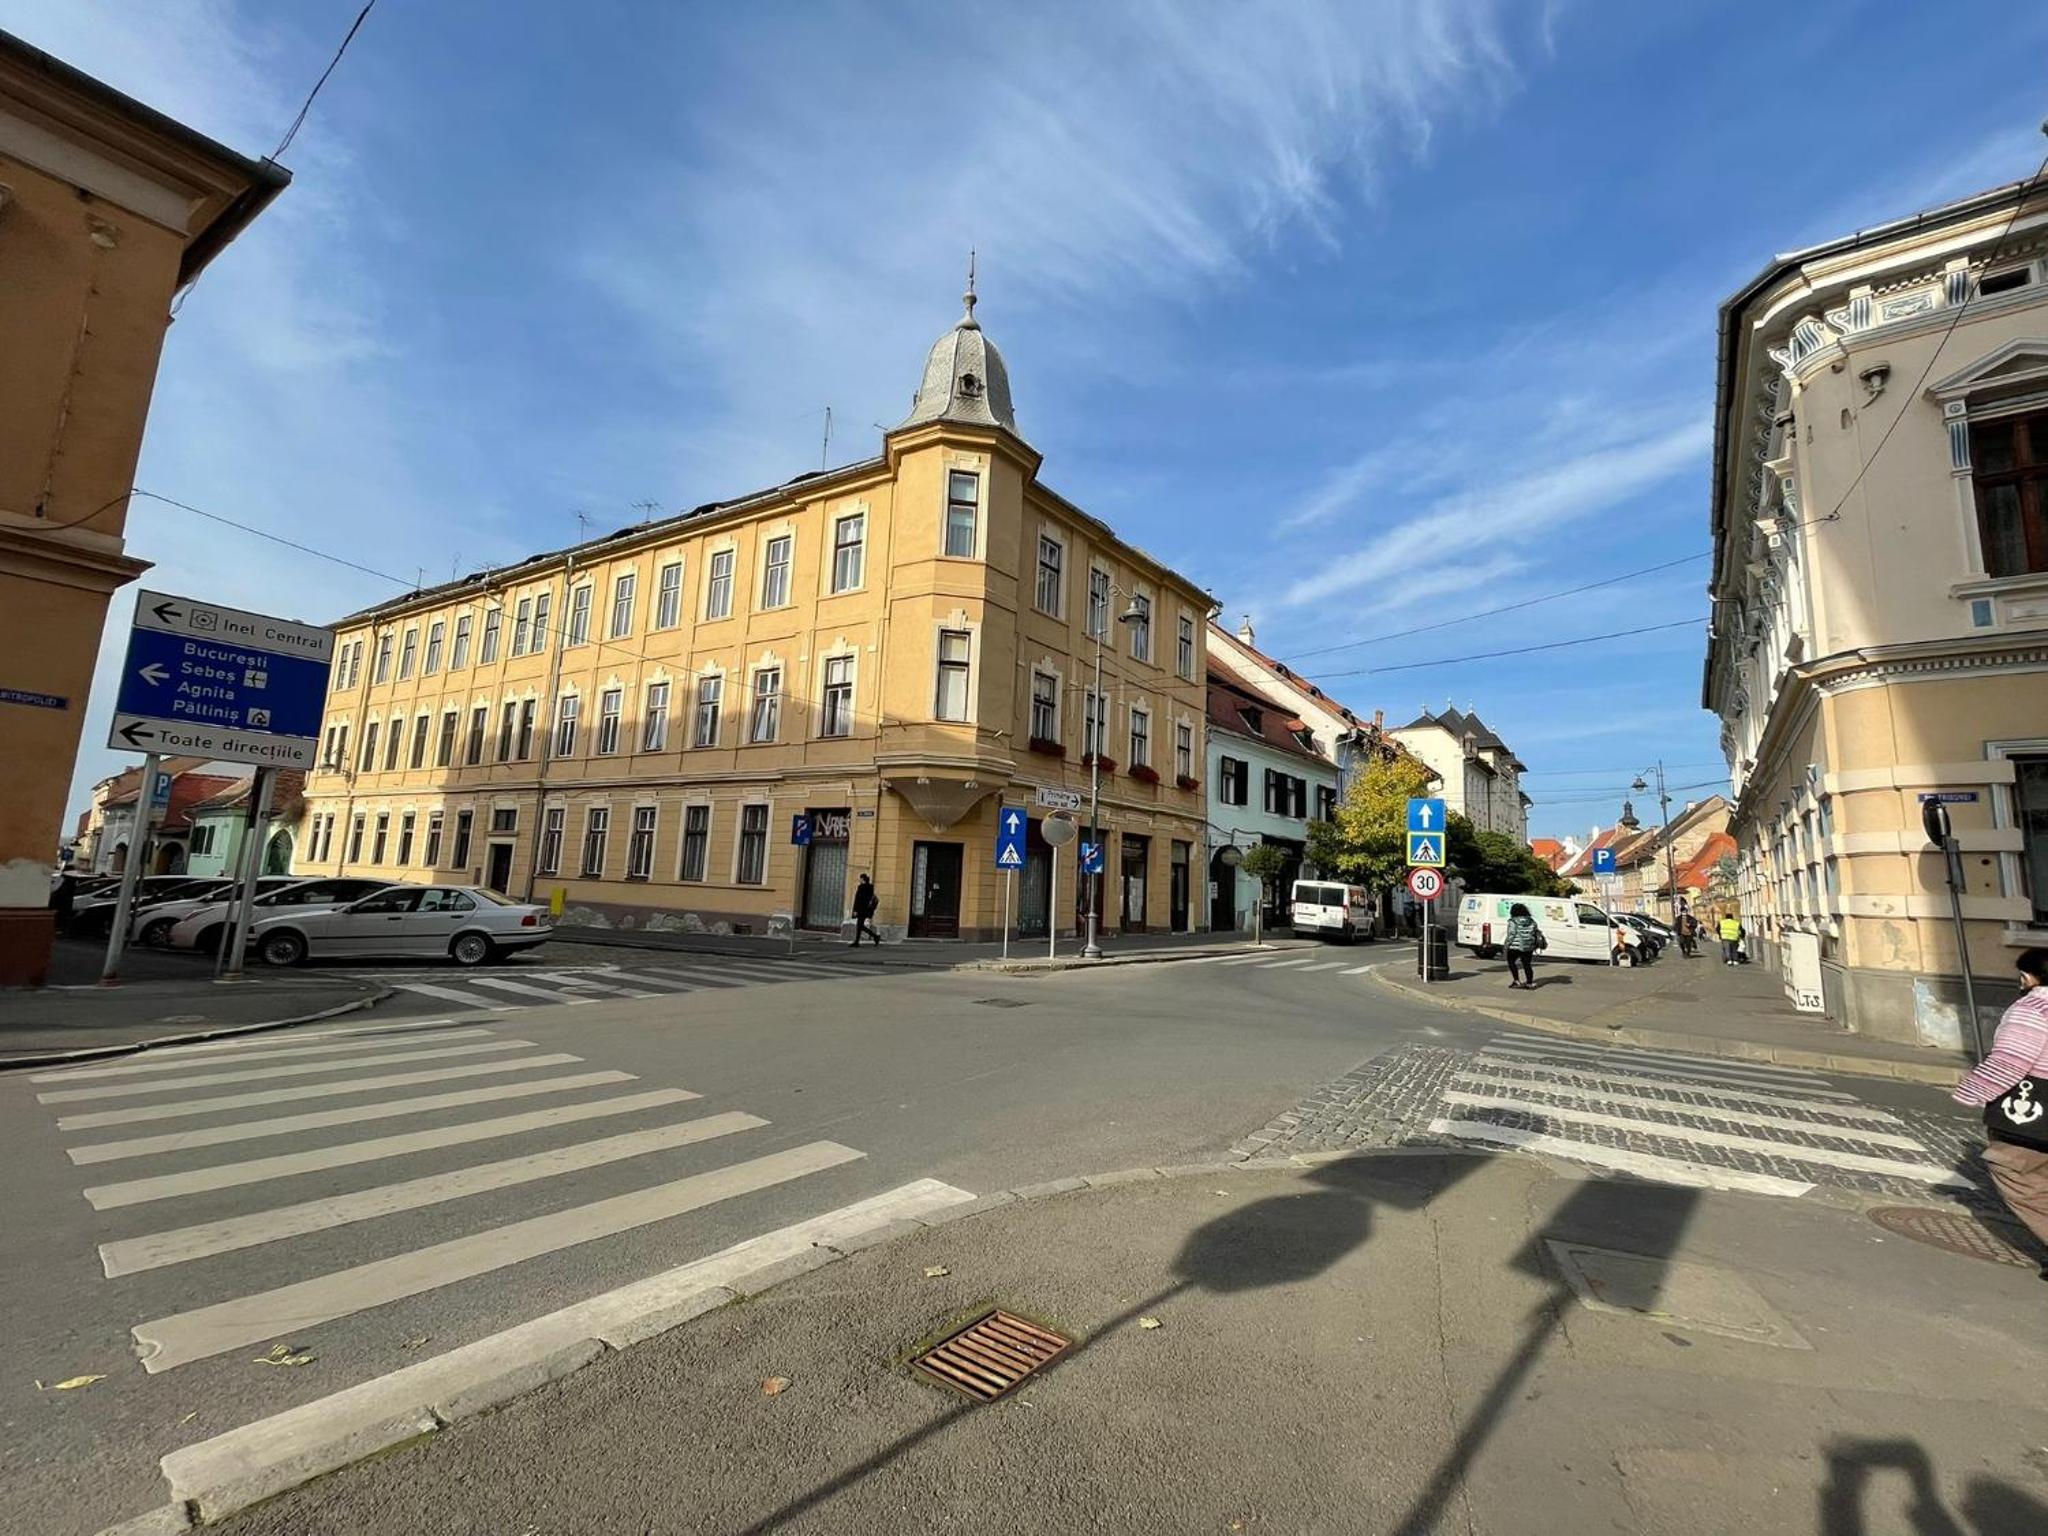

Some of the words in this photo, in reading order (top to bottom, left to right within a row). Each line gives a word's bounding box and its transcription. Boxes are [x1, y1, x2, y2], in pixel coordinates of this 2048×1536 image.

[224, 619, 255, 636] Inel
[265, 628, 323, 649] Central
[183, 642, 267, 669] București
[180, 661, 236, 685] Sebeș
[177, 681, 235, 701] Agnita
[172, 699, 240, 724] Păltiniș
[159, 730, 213, 749] Toate
[222, 739, 304, 761] direcțiile
[157, 774, 169, 794] P
[1597, 850, 1610, 865] P
[1416, 875, 1435, 891] 30
